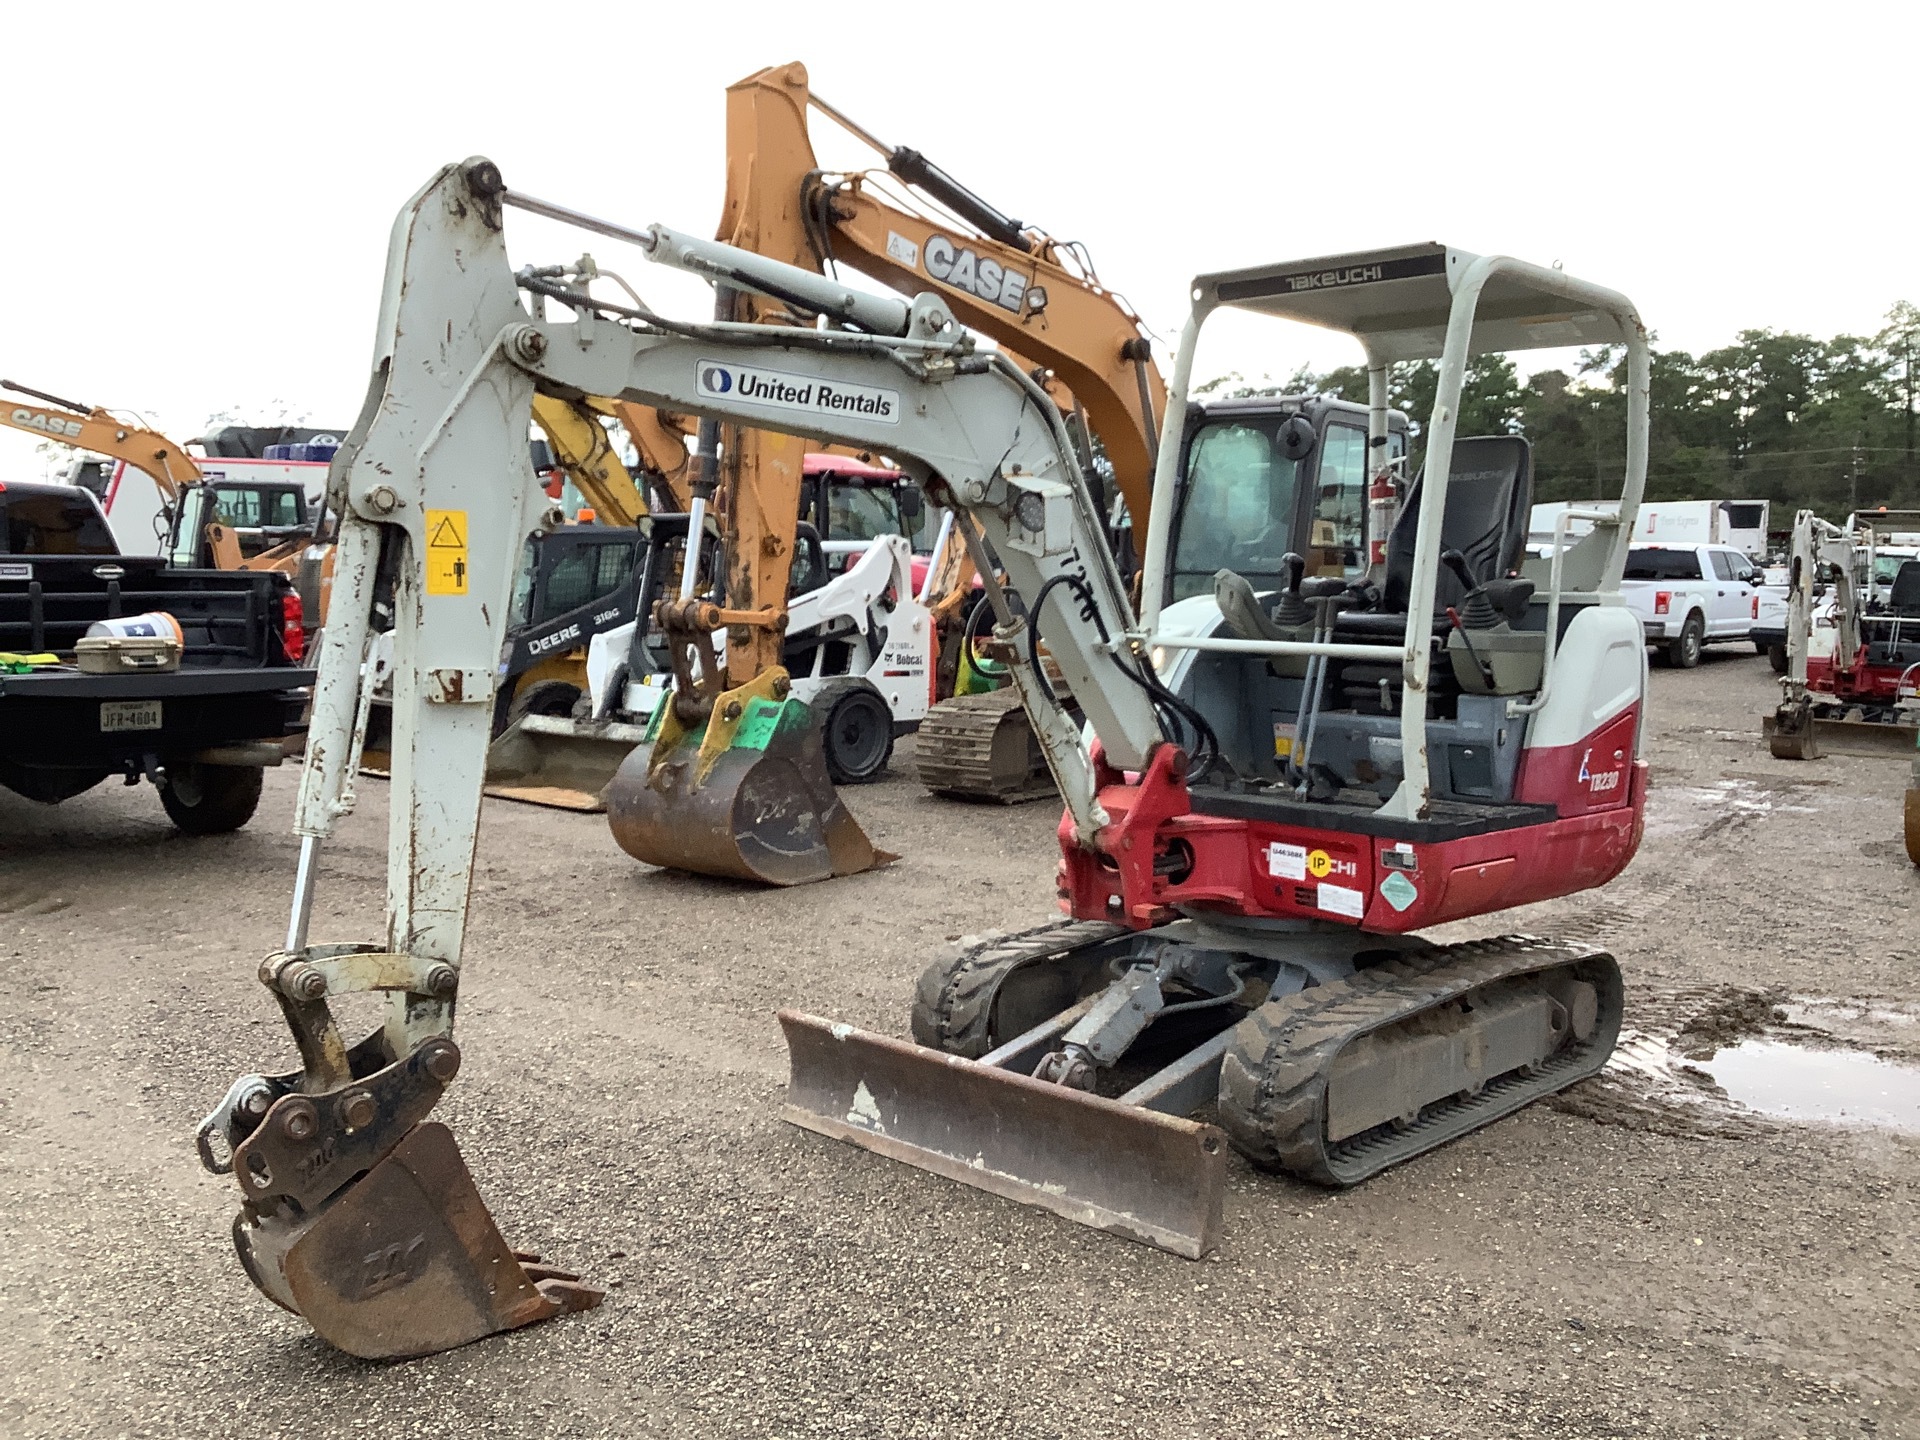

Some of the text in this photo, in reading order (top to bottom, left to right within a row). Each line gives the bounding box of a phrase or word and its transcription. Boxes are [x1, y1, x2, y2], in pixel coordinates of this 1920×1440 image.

[924, 233, 1029, 314] CASE
[1285, 265, 1382, 290] TAKEUCHI
[738, 373, 891, 416] United Rentals
[11, 408, 83, 437] CASE
[528, 607, 620, 655] DEERE 318G
[896, 653, 923, 665] Bobcat
[1313, 857, 1326, 869] IP
